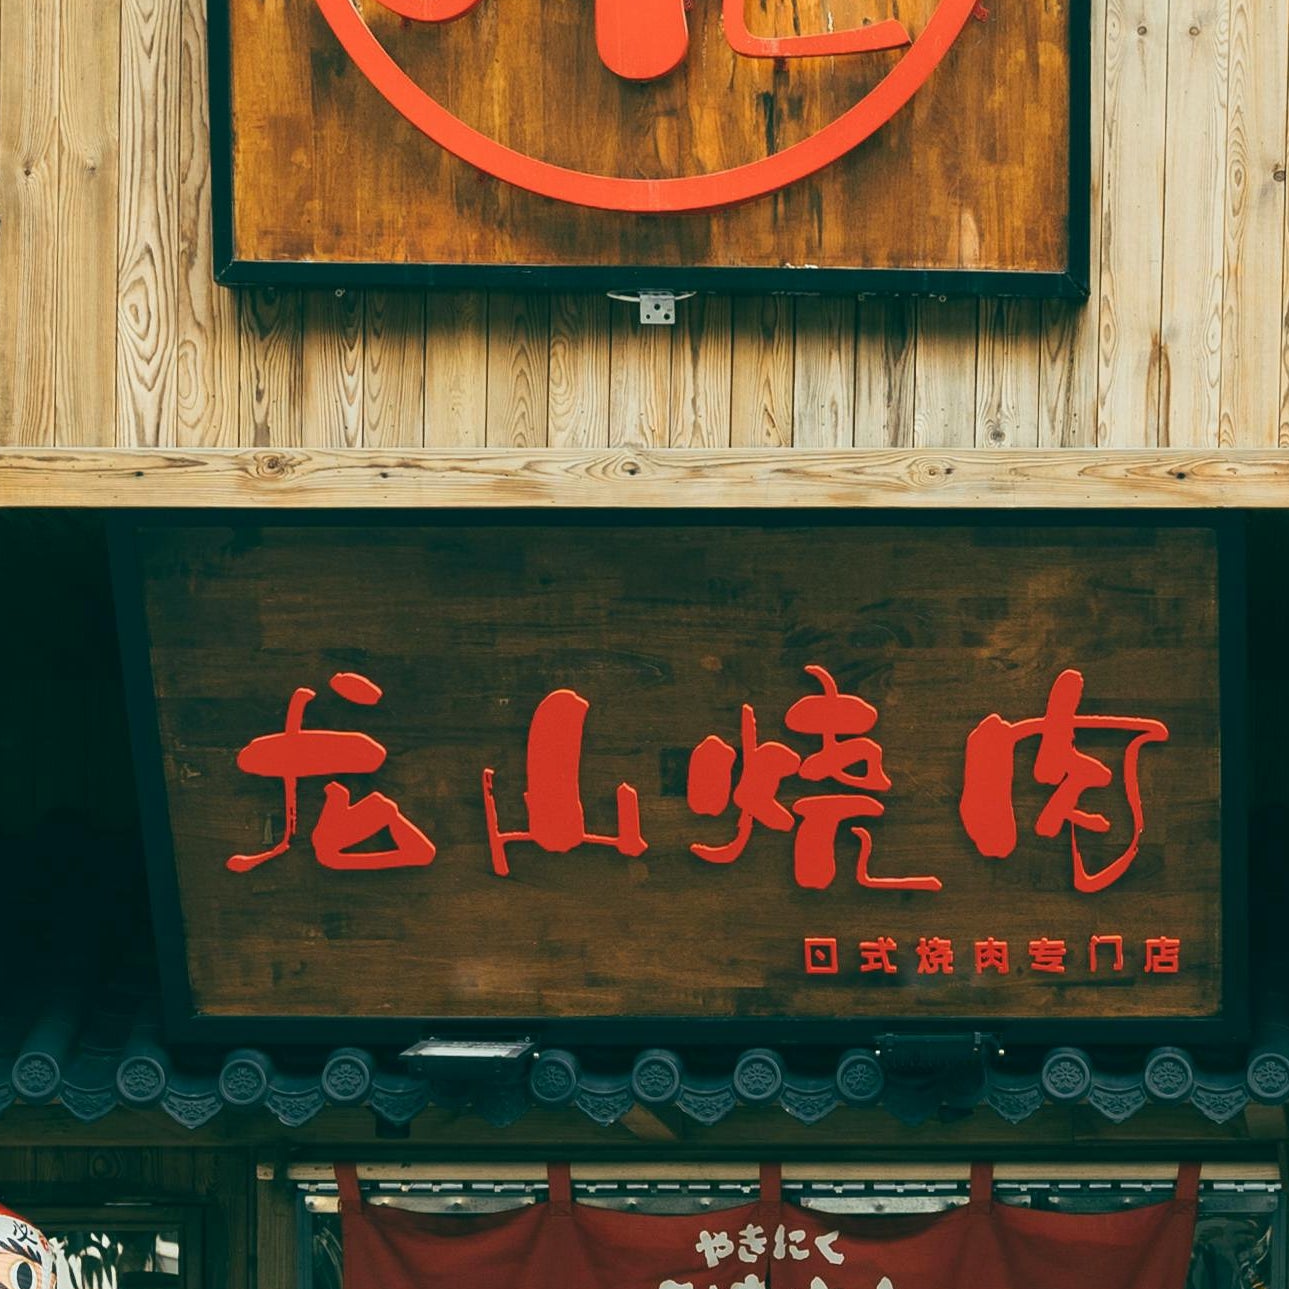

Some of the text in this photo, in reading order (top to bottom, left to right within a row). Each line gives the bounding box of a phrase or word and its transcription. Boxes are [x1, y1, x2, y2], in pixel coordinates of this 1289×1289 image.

[225, 665, 1170, 893] 龙山烧肉
[803, 935, 1183, 975] 日式烧肉专门店
[694, 1222, 845, 1268] やきにく
